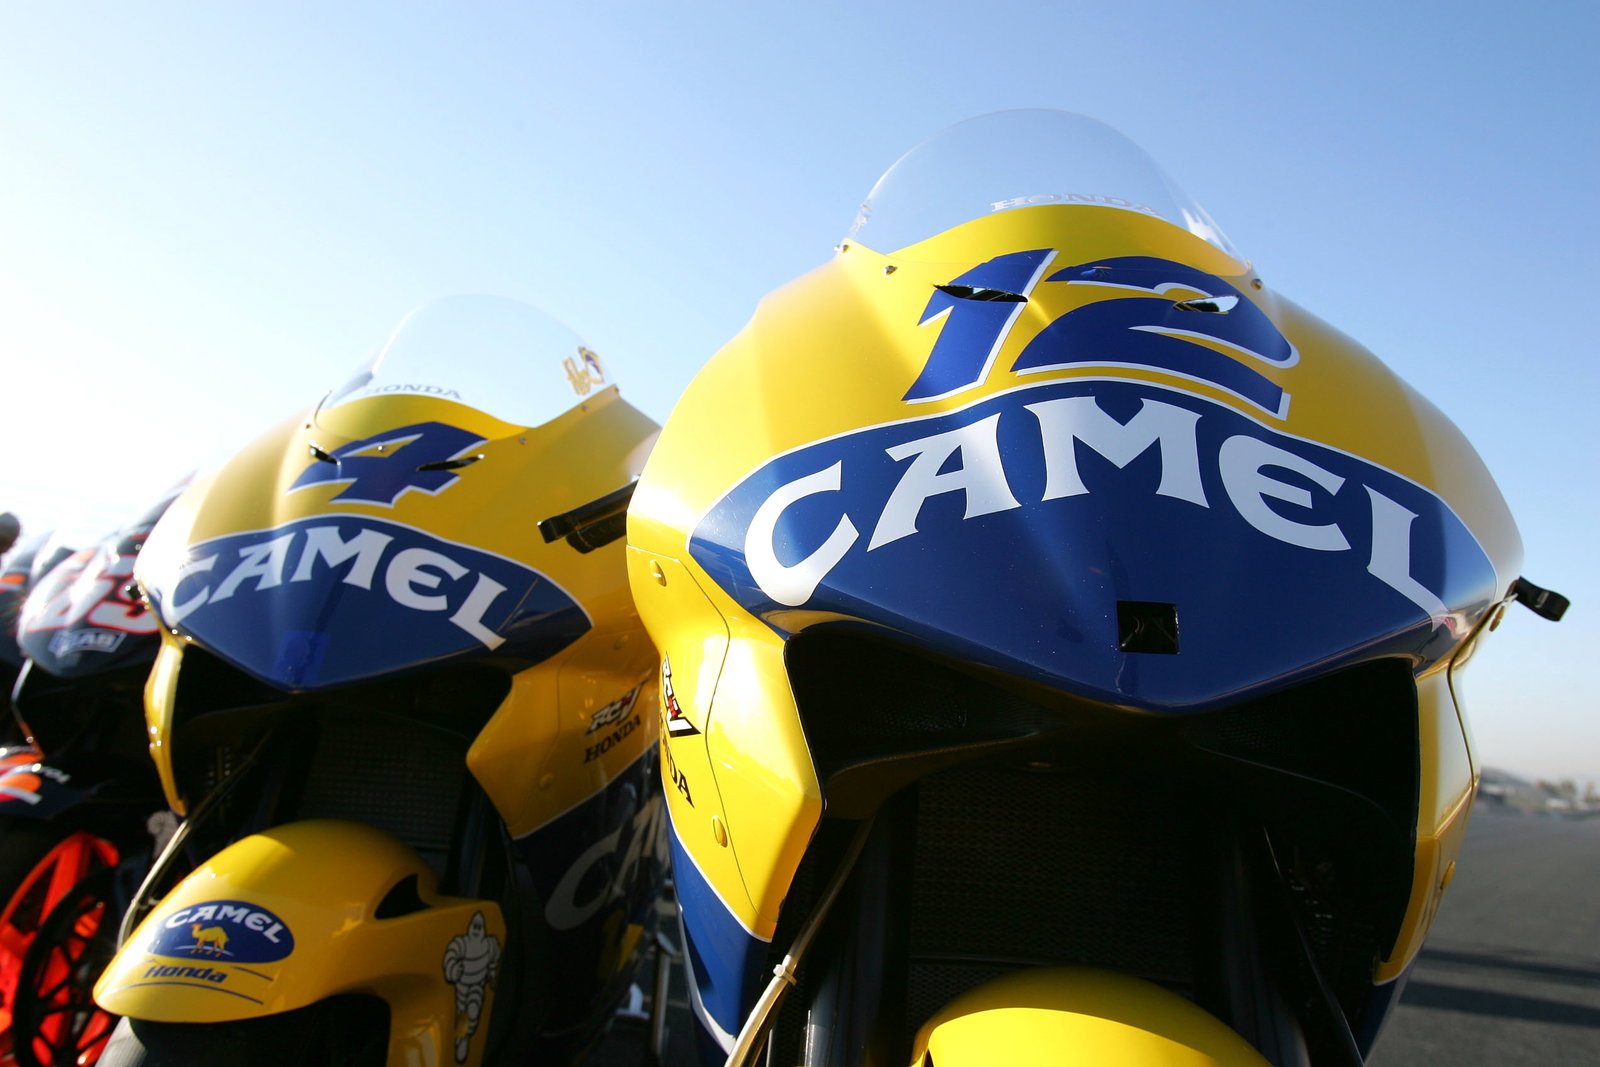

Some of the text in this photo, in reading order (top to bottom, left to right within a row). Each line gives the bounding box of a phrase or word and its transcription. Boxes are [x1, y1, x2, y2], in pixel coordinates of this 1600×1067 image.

[901, 247, 1300, 421] 12
[284, 421, 489, 508] 4
[744, 396, 1450, 629] CAMEL
[161, 526, 508, 651] CAMEL
[584, 714, 641, 764] HONDA
[165, 904, 284, 944] CAMEL
[143, 964, 228, 984] Honda
